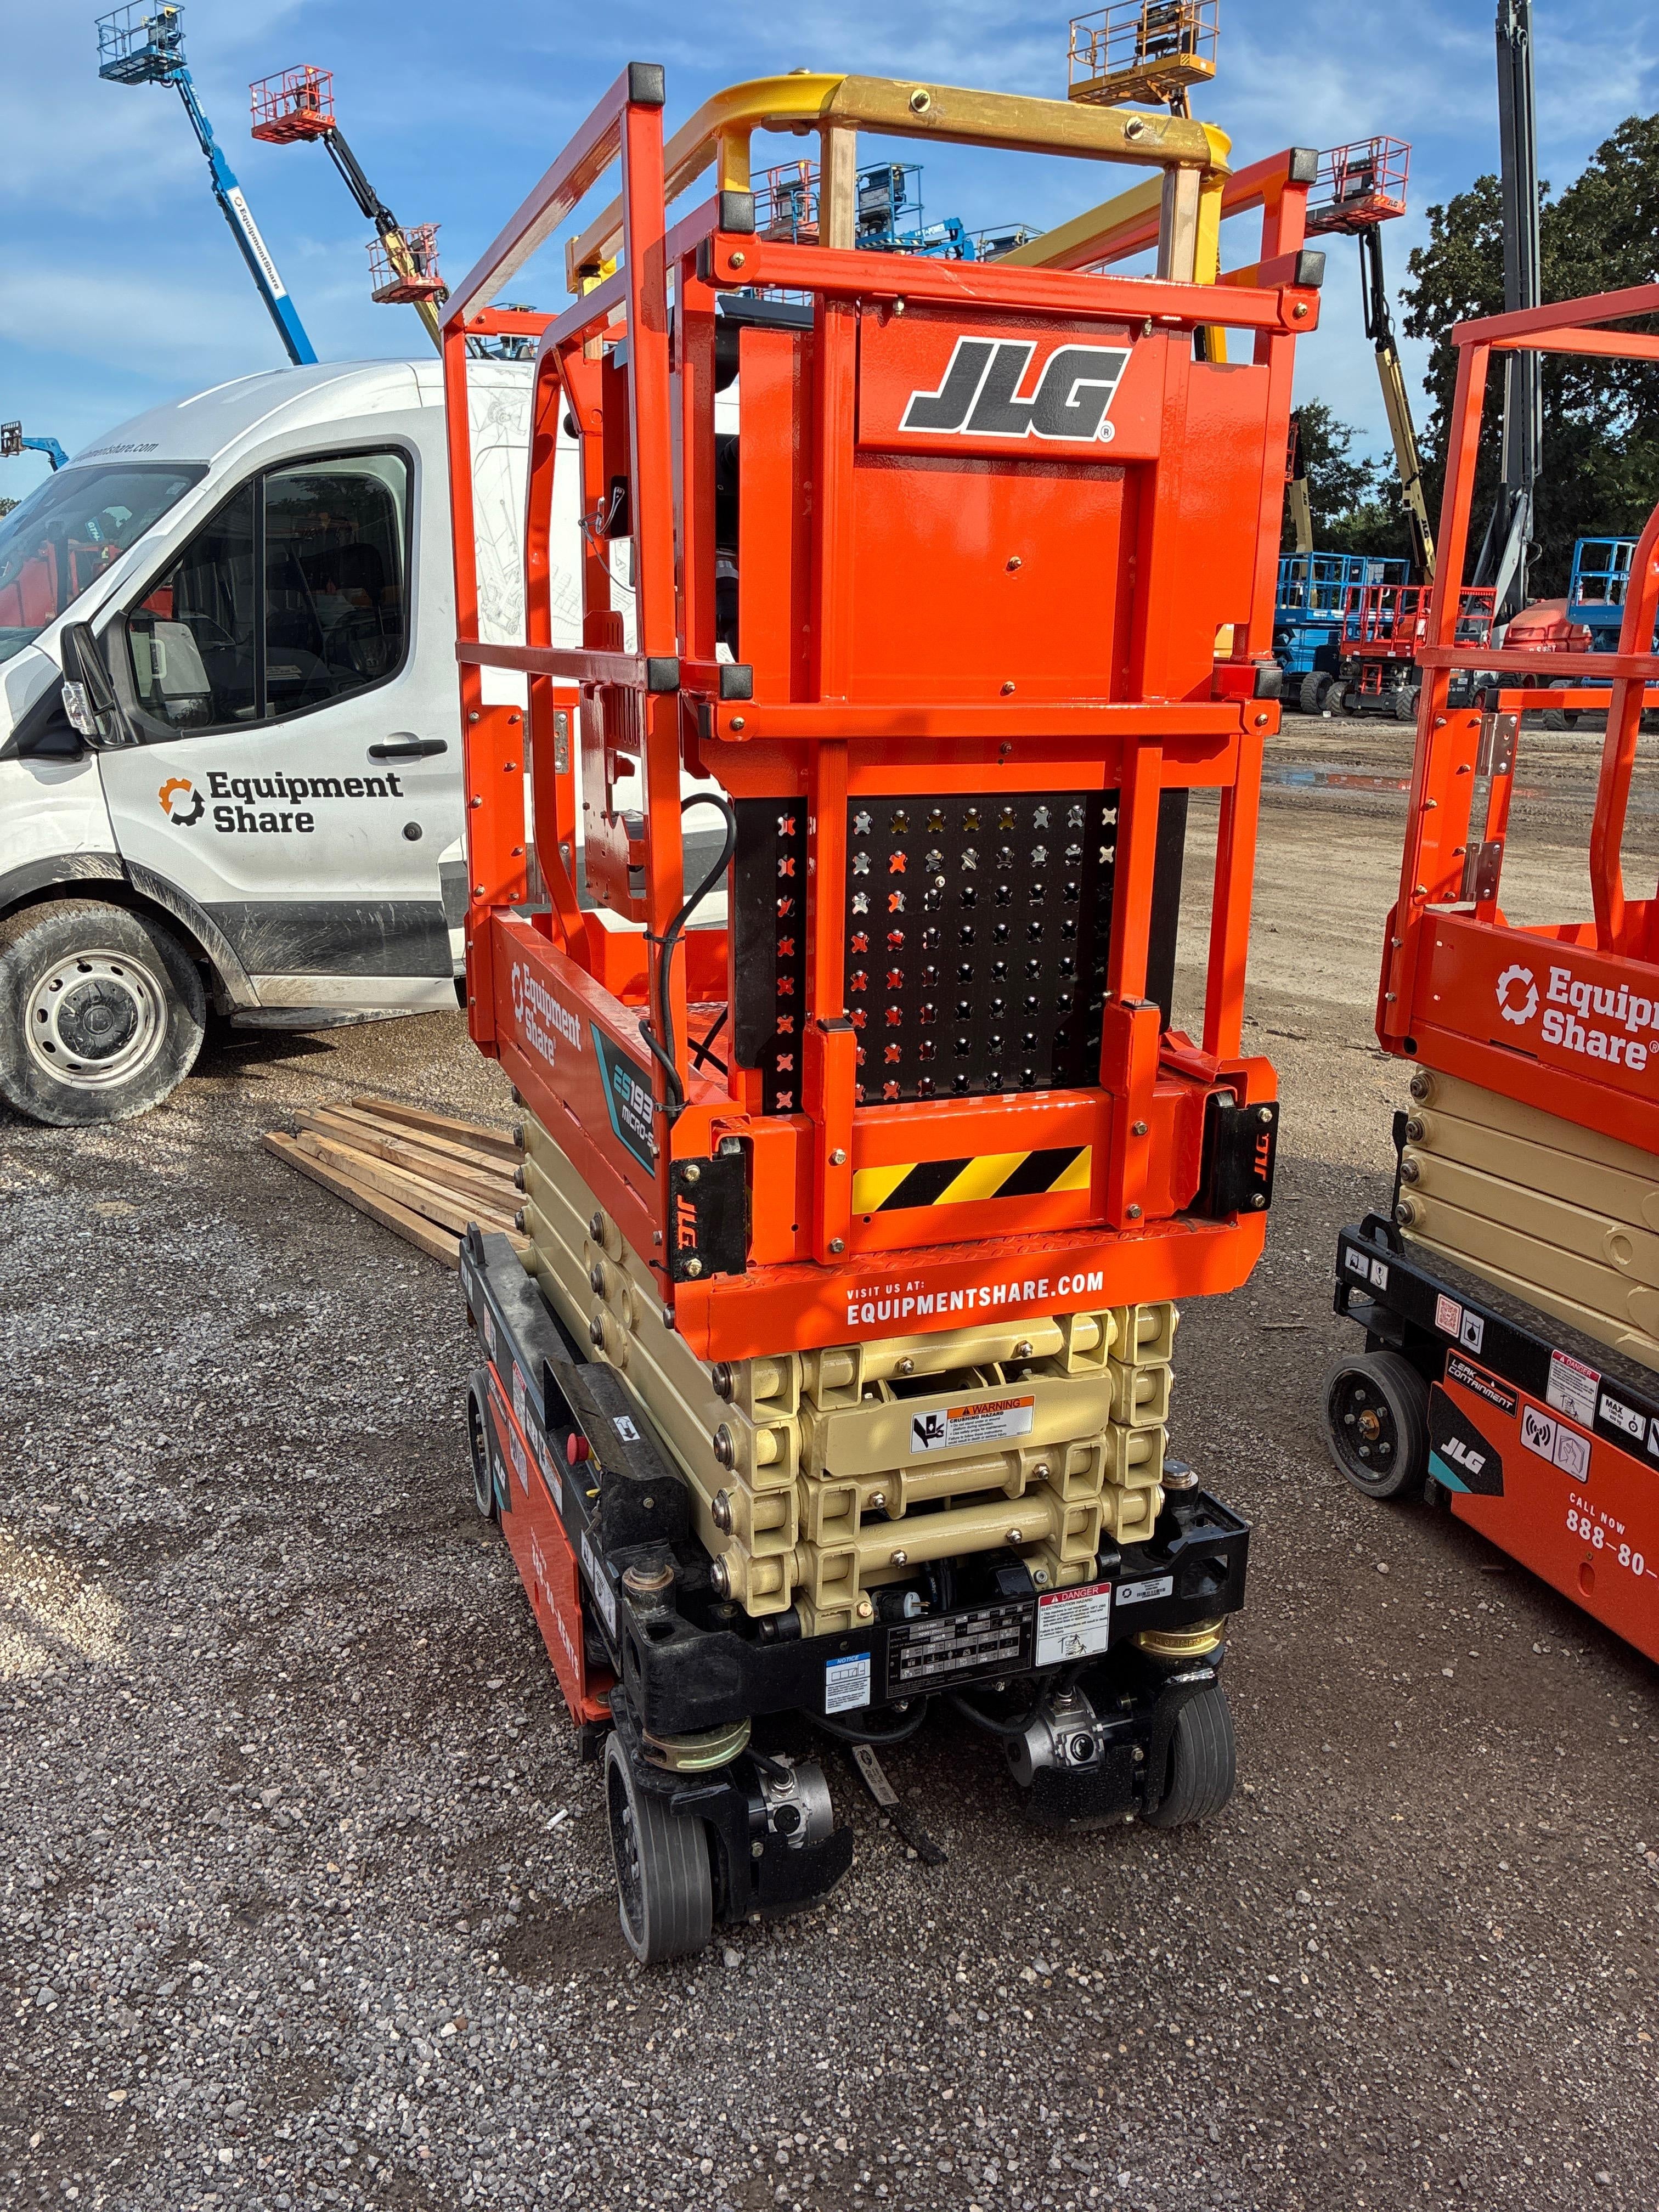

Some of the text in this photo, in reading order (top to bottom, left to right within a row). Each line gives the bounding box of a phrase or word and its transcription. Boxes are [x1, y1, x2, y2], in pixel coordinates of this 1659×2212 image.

[206, 771, 404, 805] Equipment
[213, 805, 315, 833] Share
[523, 963, 582, 1052] Equipment
[1254, 1132, 1270, 1182] JLG
[677, 1195, 698, 1250] JLG
[847, 1281, 925, 1300] VISIT US AT:
[847, 1271, 1103, 1325] EQUIPMENTSHARE.COM
[1452, 1359, 1477, 1378] LEAK
[1567, 1359, 1592, 1378] DANGER
[1448, 1365, 1513, 1408] CONTAINMENT
[973, 1400, 1020, 1414] WARNING
[1606, 1399, 1623, 1414] MAX
[1440, 1437, 1486, 1475] JLG
[1570, 1492, 1625, 1535] CALL NOW
[1041, 1602, 1075, 1611] ELECTROCUTION
[1062, 1587, 1099, 1601] DANGER
[837, 1655, 859, 1663] NOTICE
